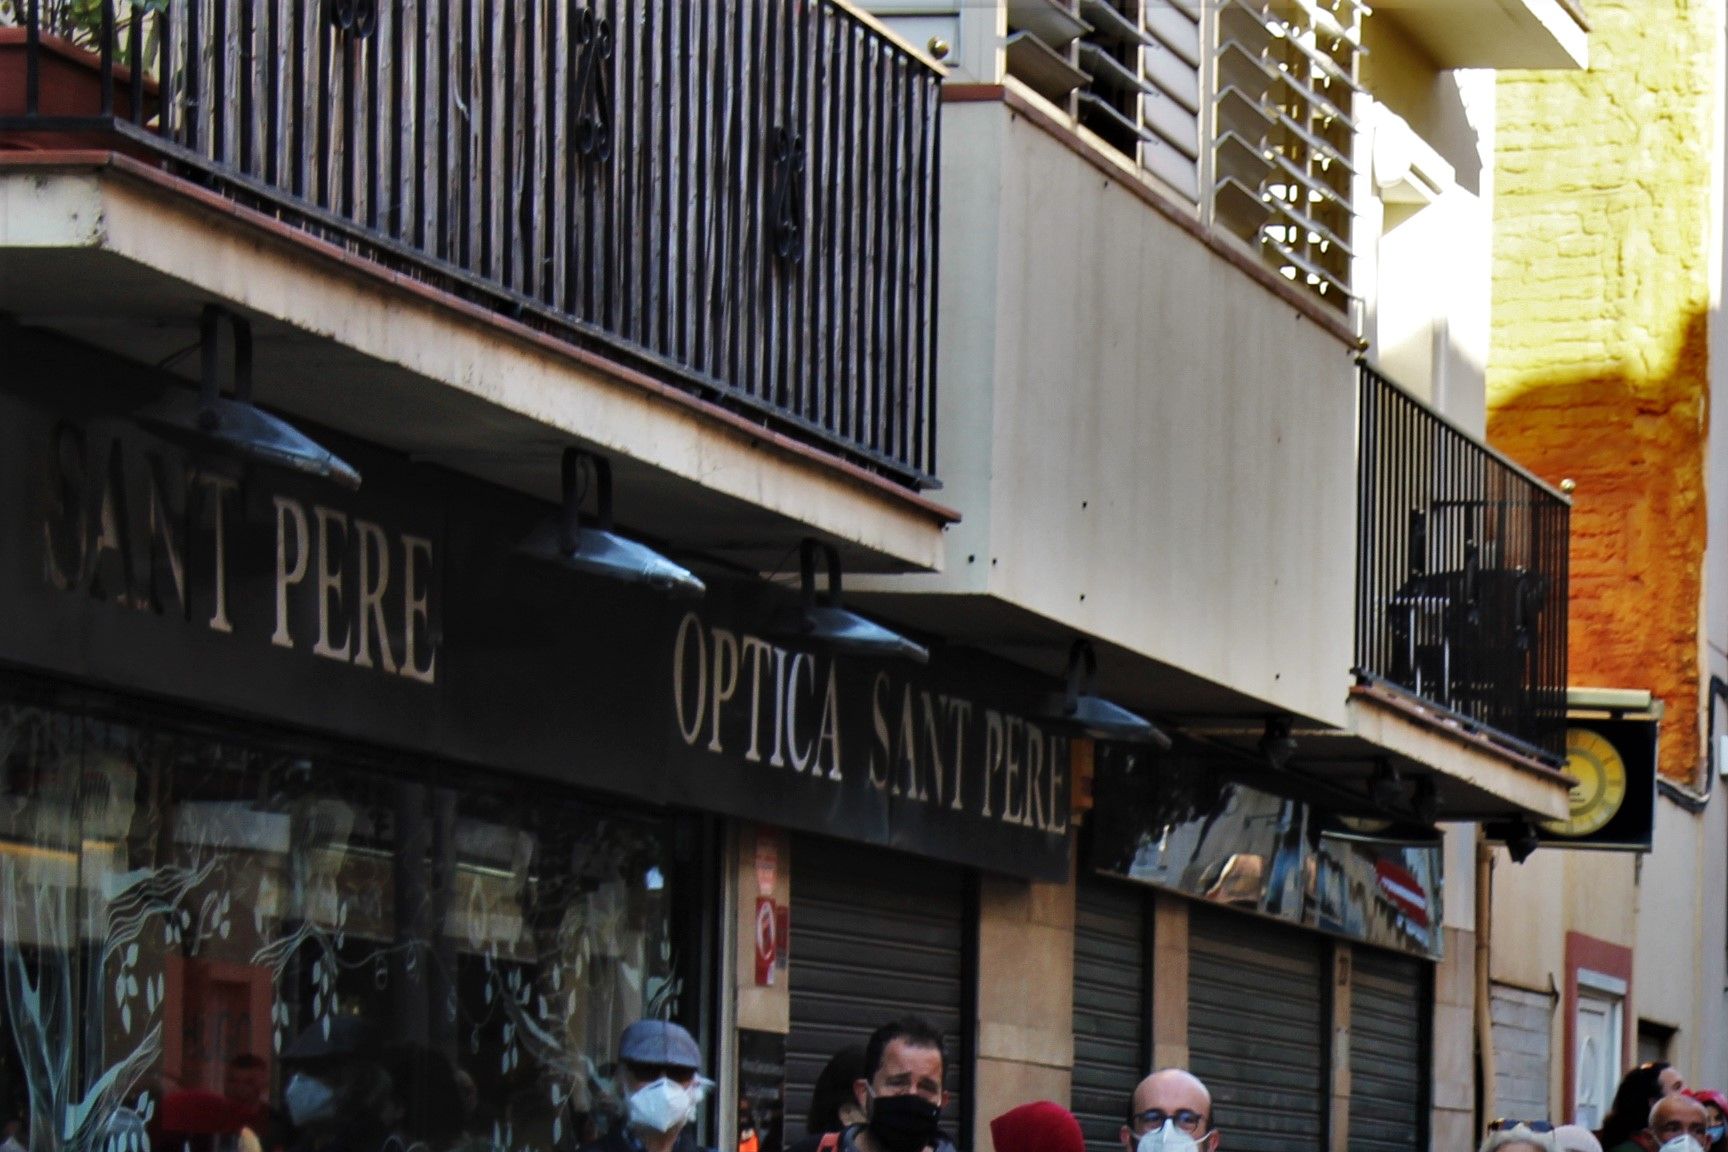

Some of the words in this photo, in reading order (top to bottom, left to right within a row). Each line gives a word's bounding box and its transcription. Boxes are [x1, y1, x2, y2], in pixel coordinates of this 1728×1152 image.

[271, 495, 437, 685] PERE
[673, 610, 843, 781] OPTICA
[867, 670, 973, 810] SANT
[981, 709, 1068, 836] PERE
